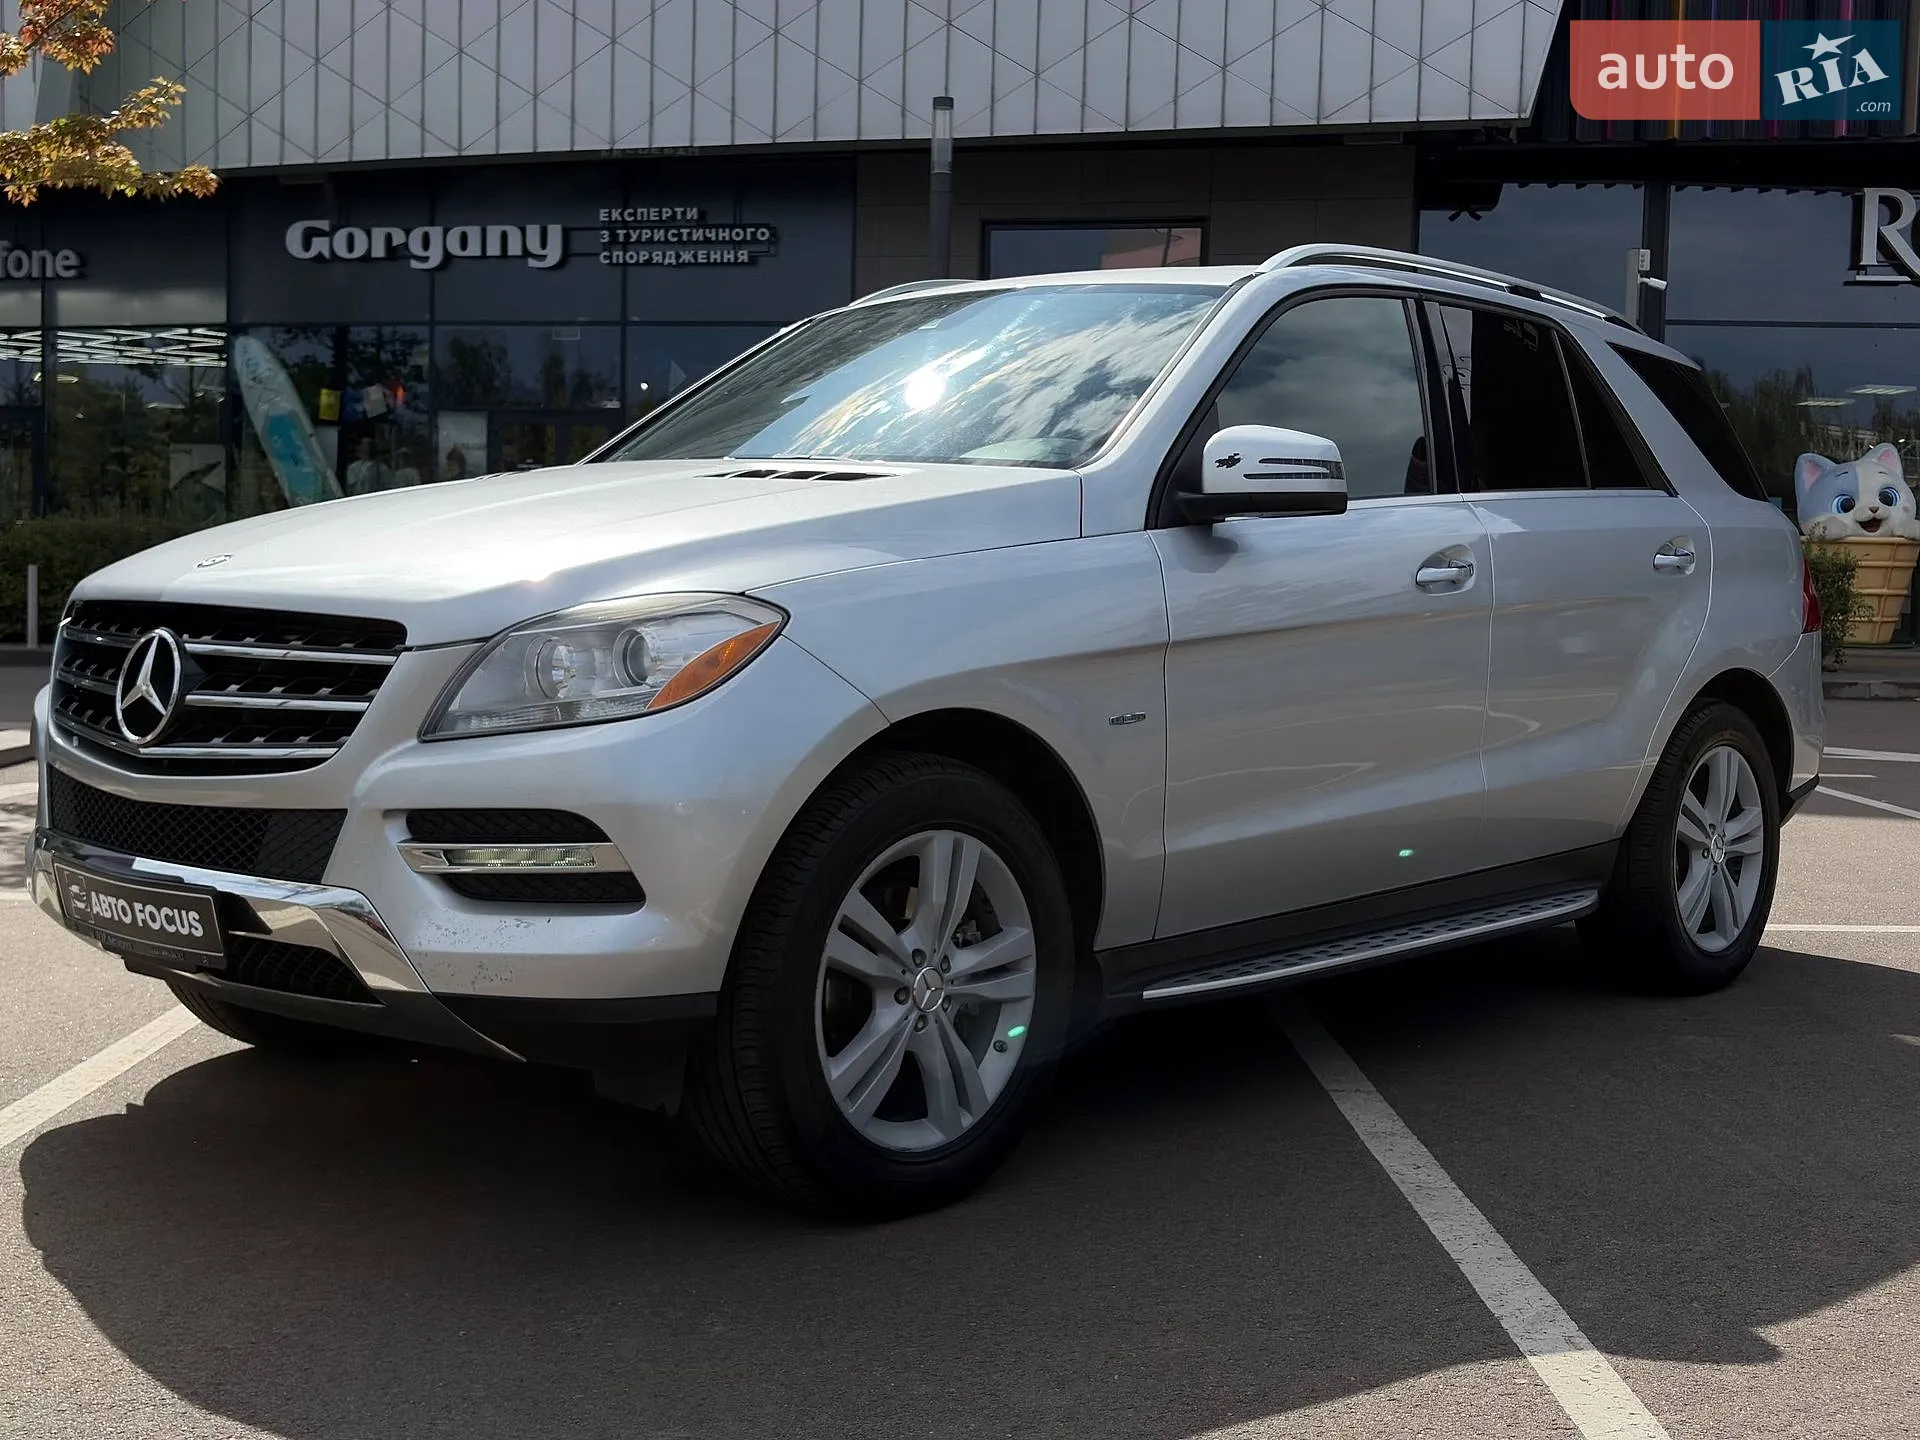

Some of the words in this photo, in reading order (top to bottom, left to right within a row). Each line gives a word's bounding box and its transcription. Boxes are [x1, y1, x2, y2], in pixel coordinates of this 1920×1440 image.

[599, 207, 699, 222] ЕКСПЕРТИ
[615, 227, 771, 243] ТУРИСТИЧНОГО
[285, 219, 563, 270] Gorgany
[599, 249, 750, 266] СПОРЯДЖЕННЯ
[133, 902, 204, 937] FOCUS
